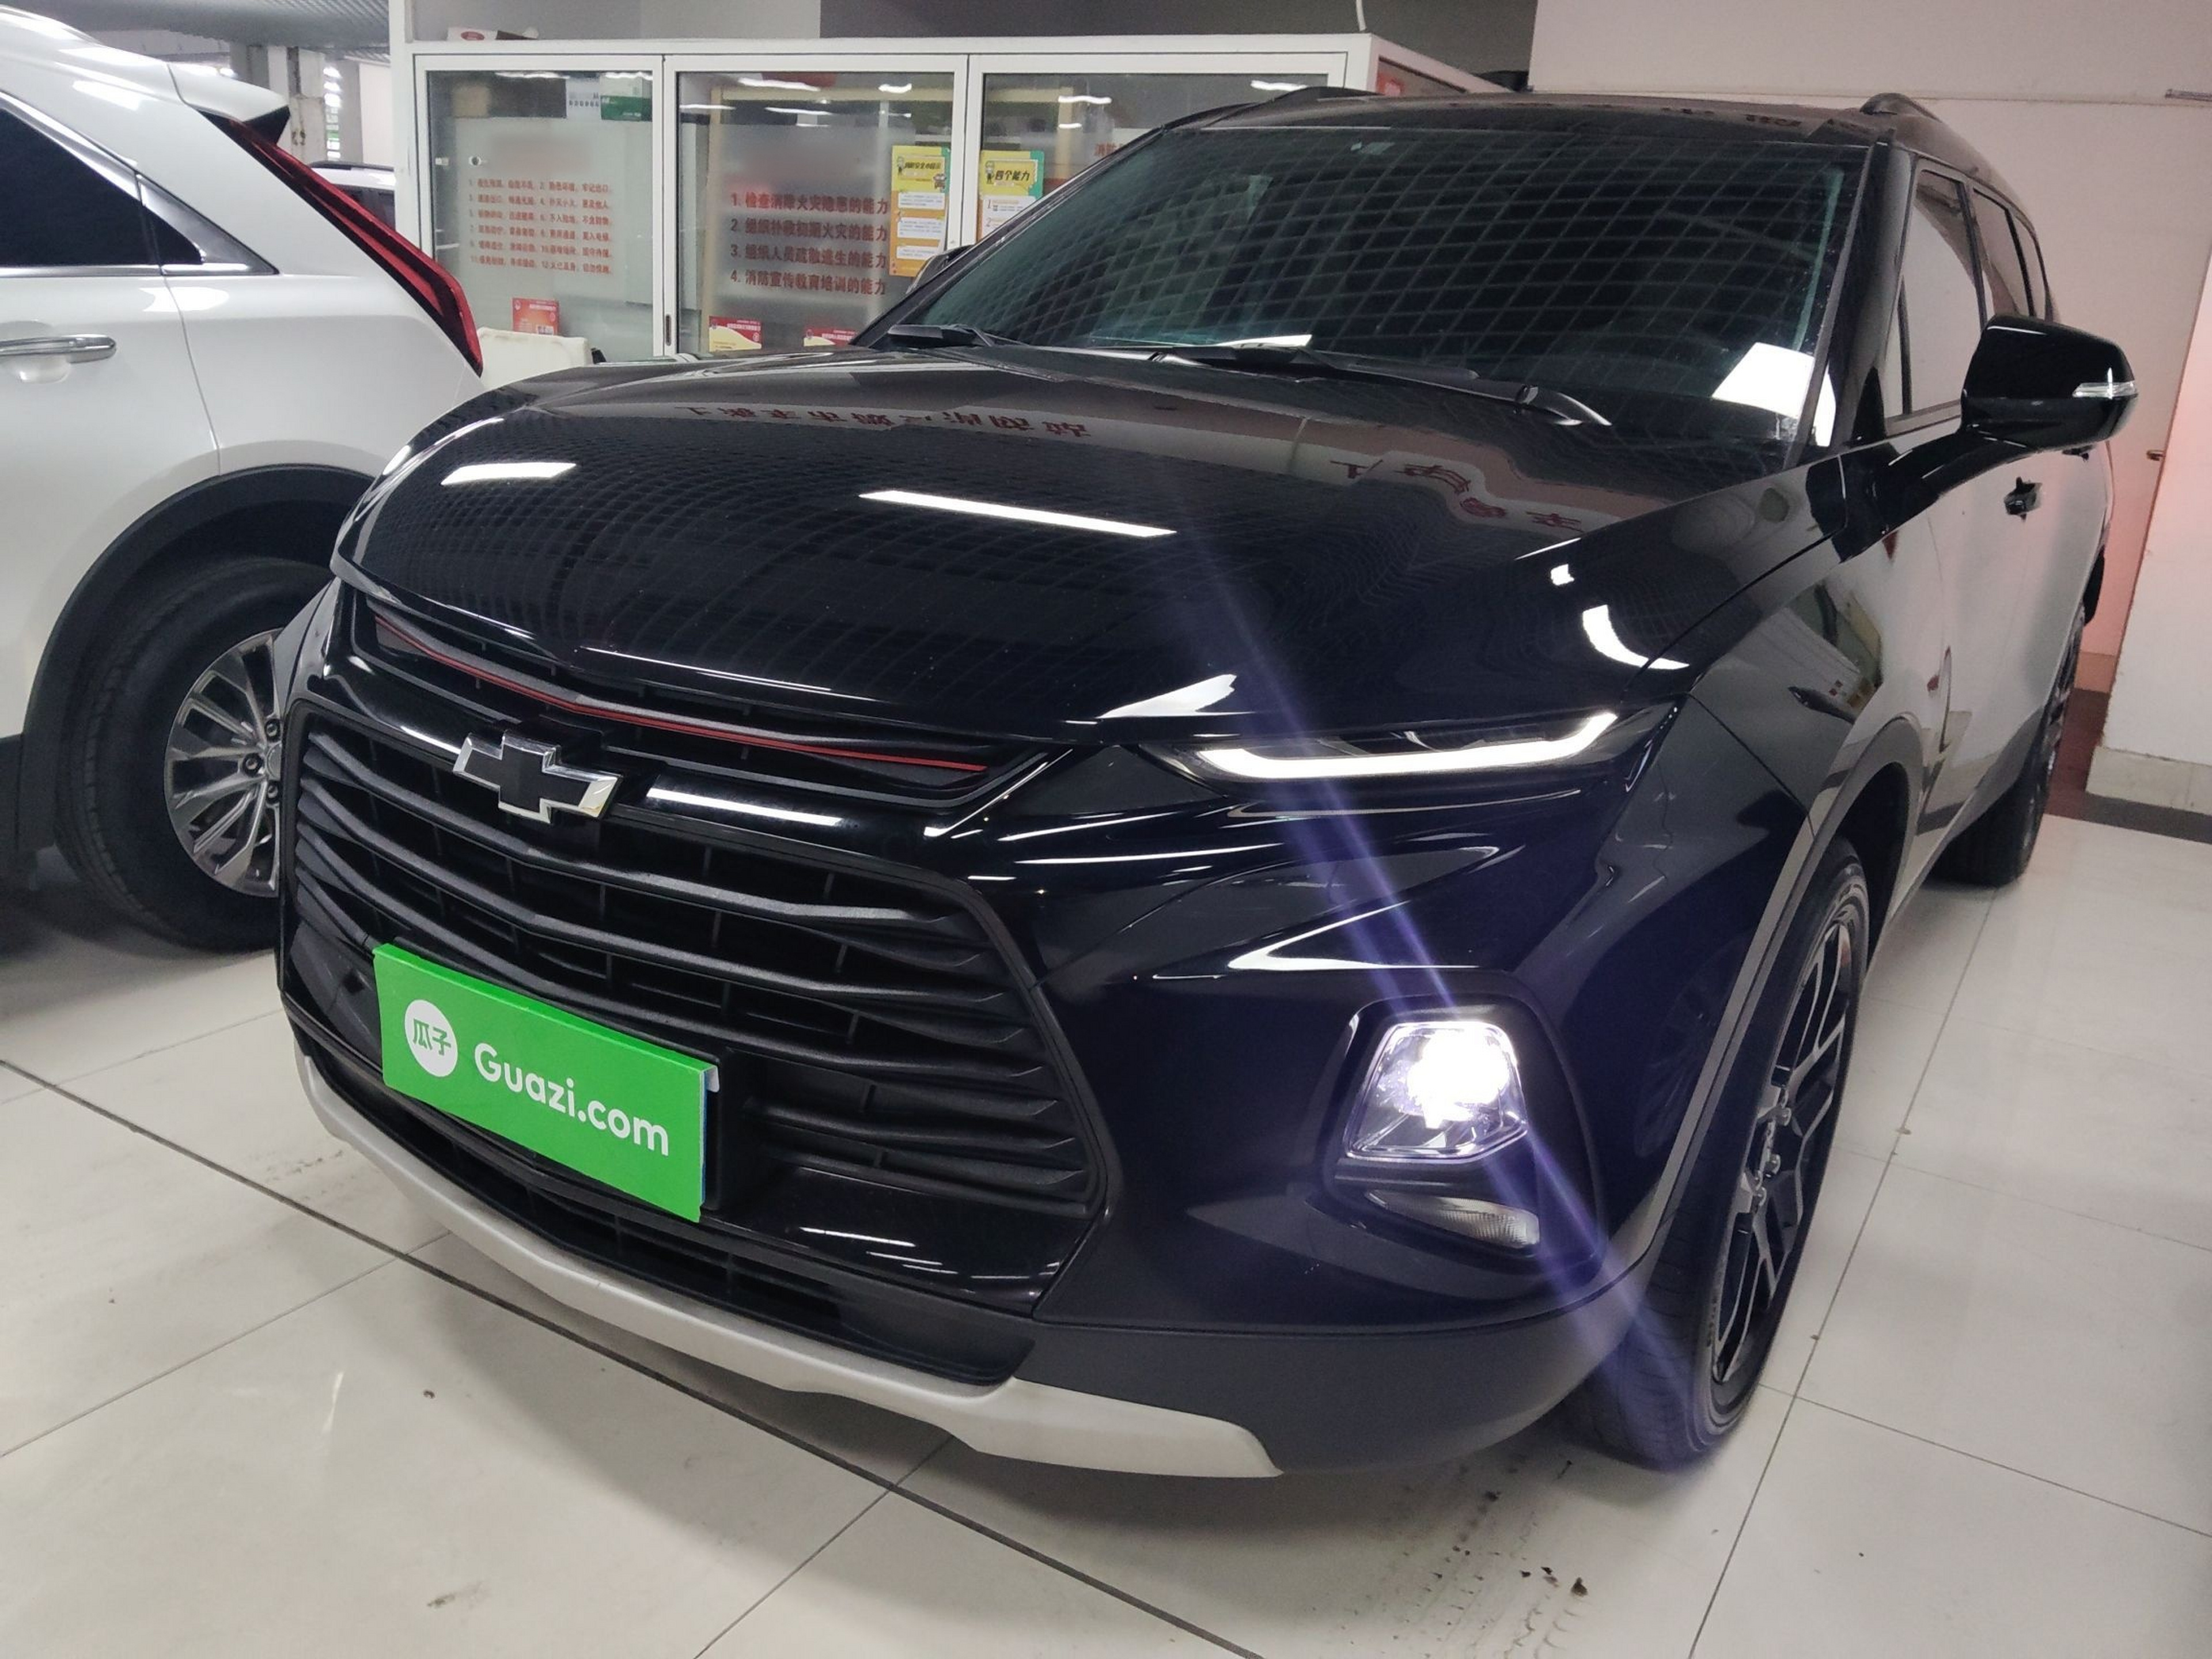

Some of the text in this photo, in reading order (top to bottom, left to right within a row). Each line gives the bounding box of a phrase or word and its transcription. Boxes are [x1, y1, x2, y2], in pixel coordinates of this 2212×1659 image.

[995, 170, 1030, 181] 四个能力
[412, 1017, 452, 1055] 瓜子
[474, 1042, 669, 1156] Guazi.com
